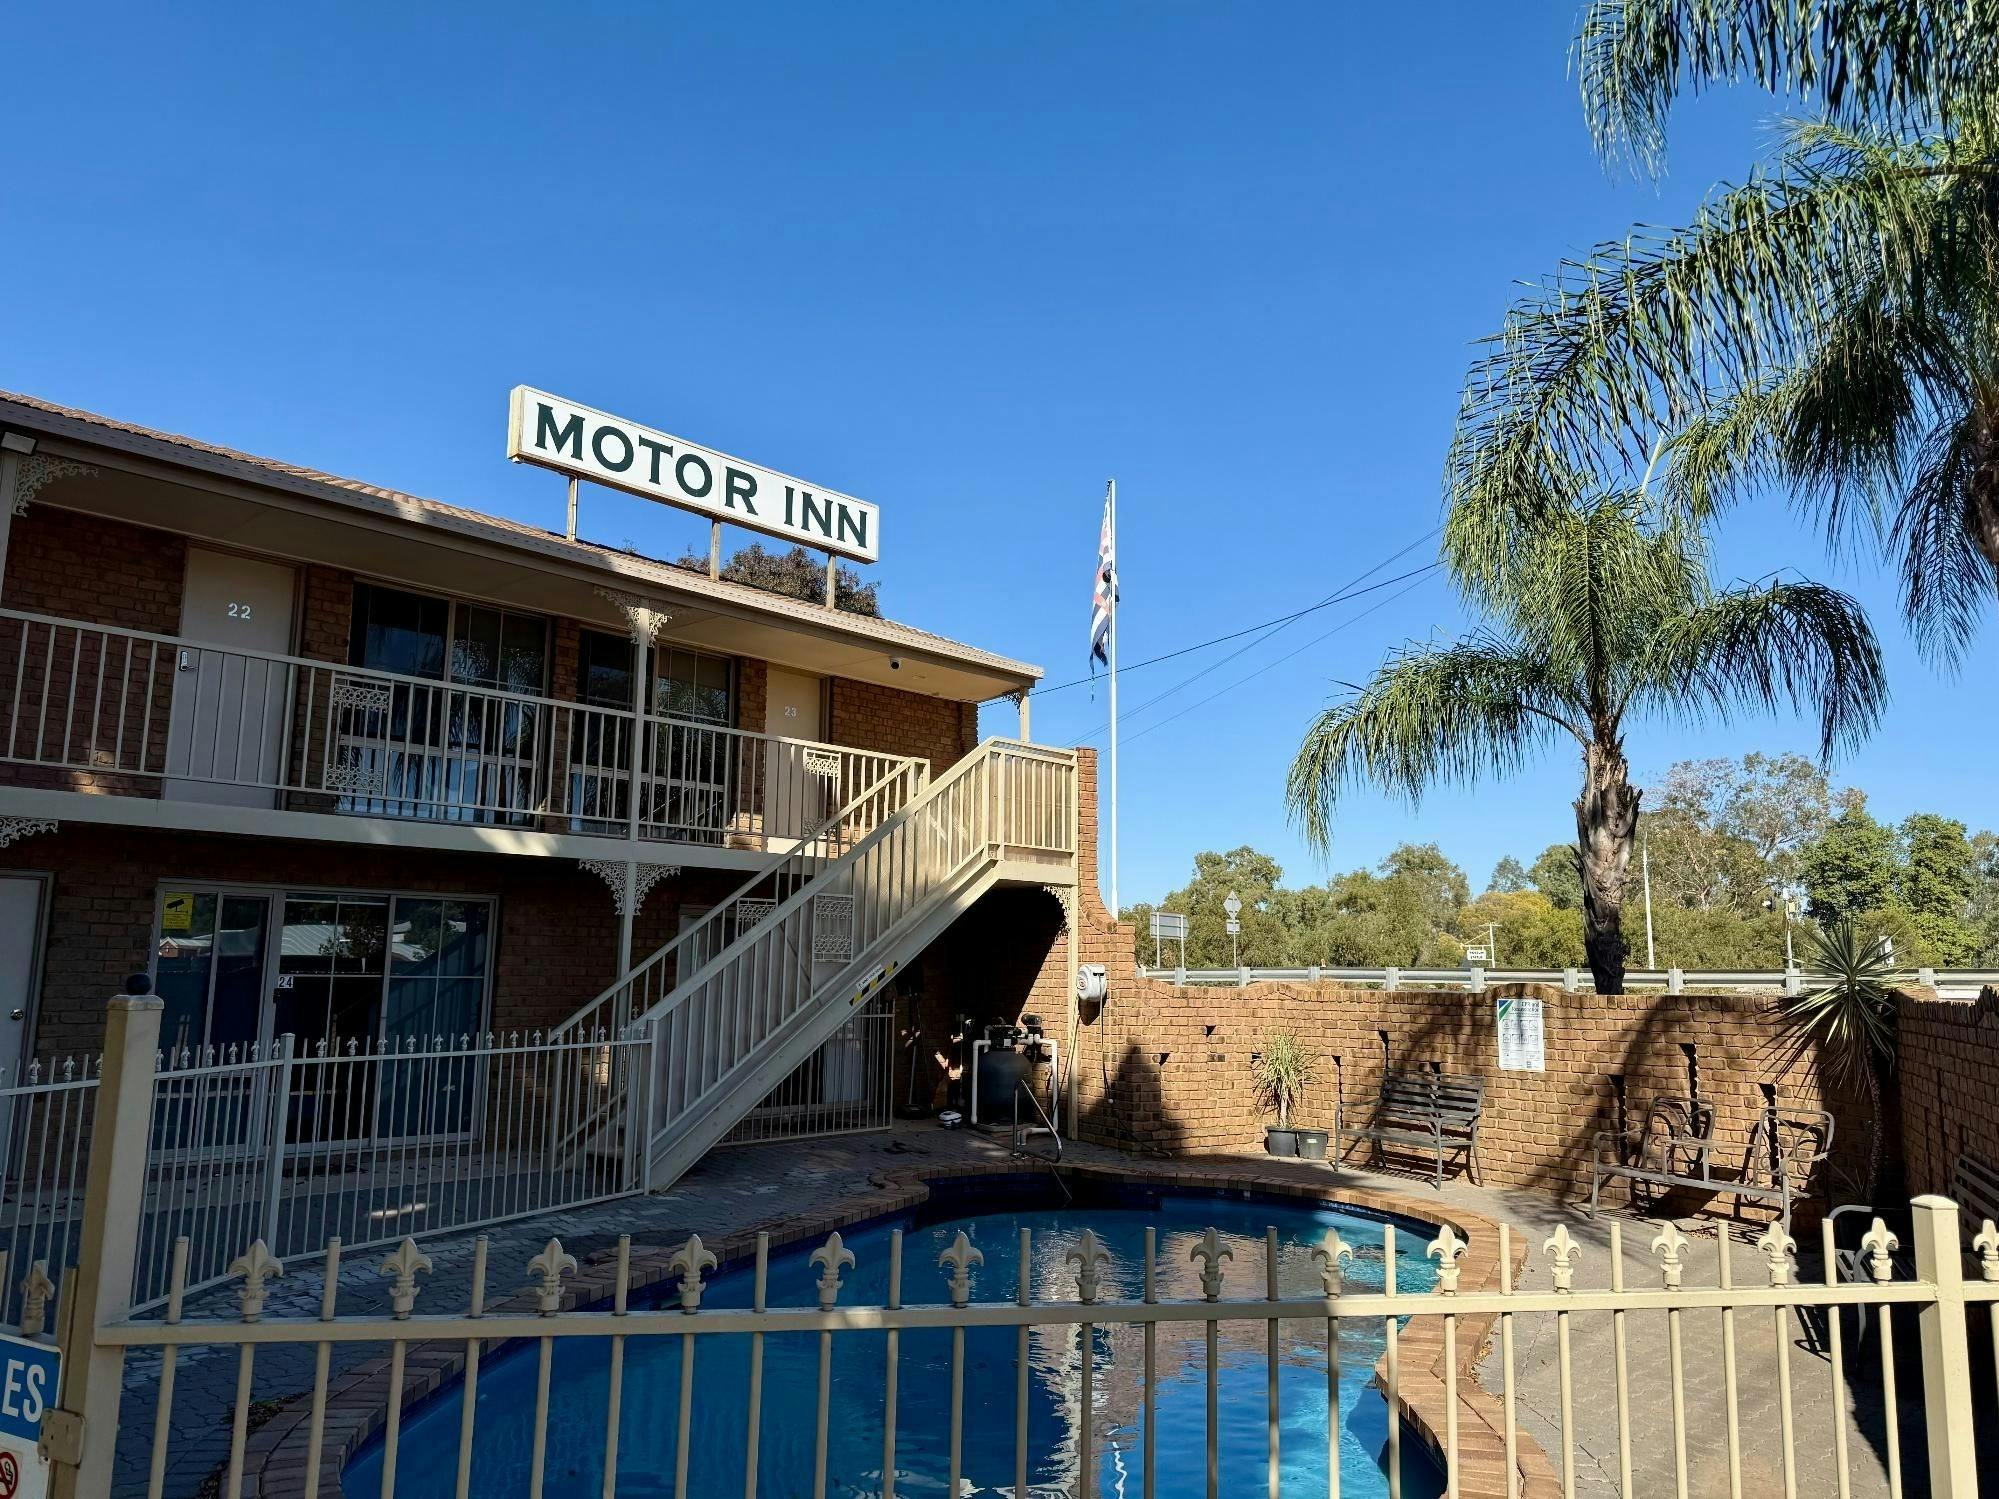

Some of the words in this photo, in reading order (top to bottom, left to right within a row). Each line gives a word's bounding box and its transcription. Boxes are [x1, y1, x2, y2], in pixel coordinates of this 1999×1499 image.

[534, 402, 759, 516] MOTOR
[783, 485, 868, 549] INN
[228, 602, 251, 619] 22
[784, 705, 797, 717] 23
[279, 976, 293, 988] 24
[2, 1358, 46, 1423] ES
